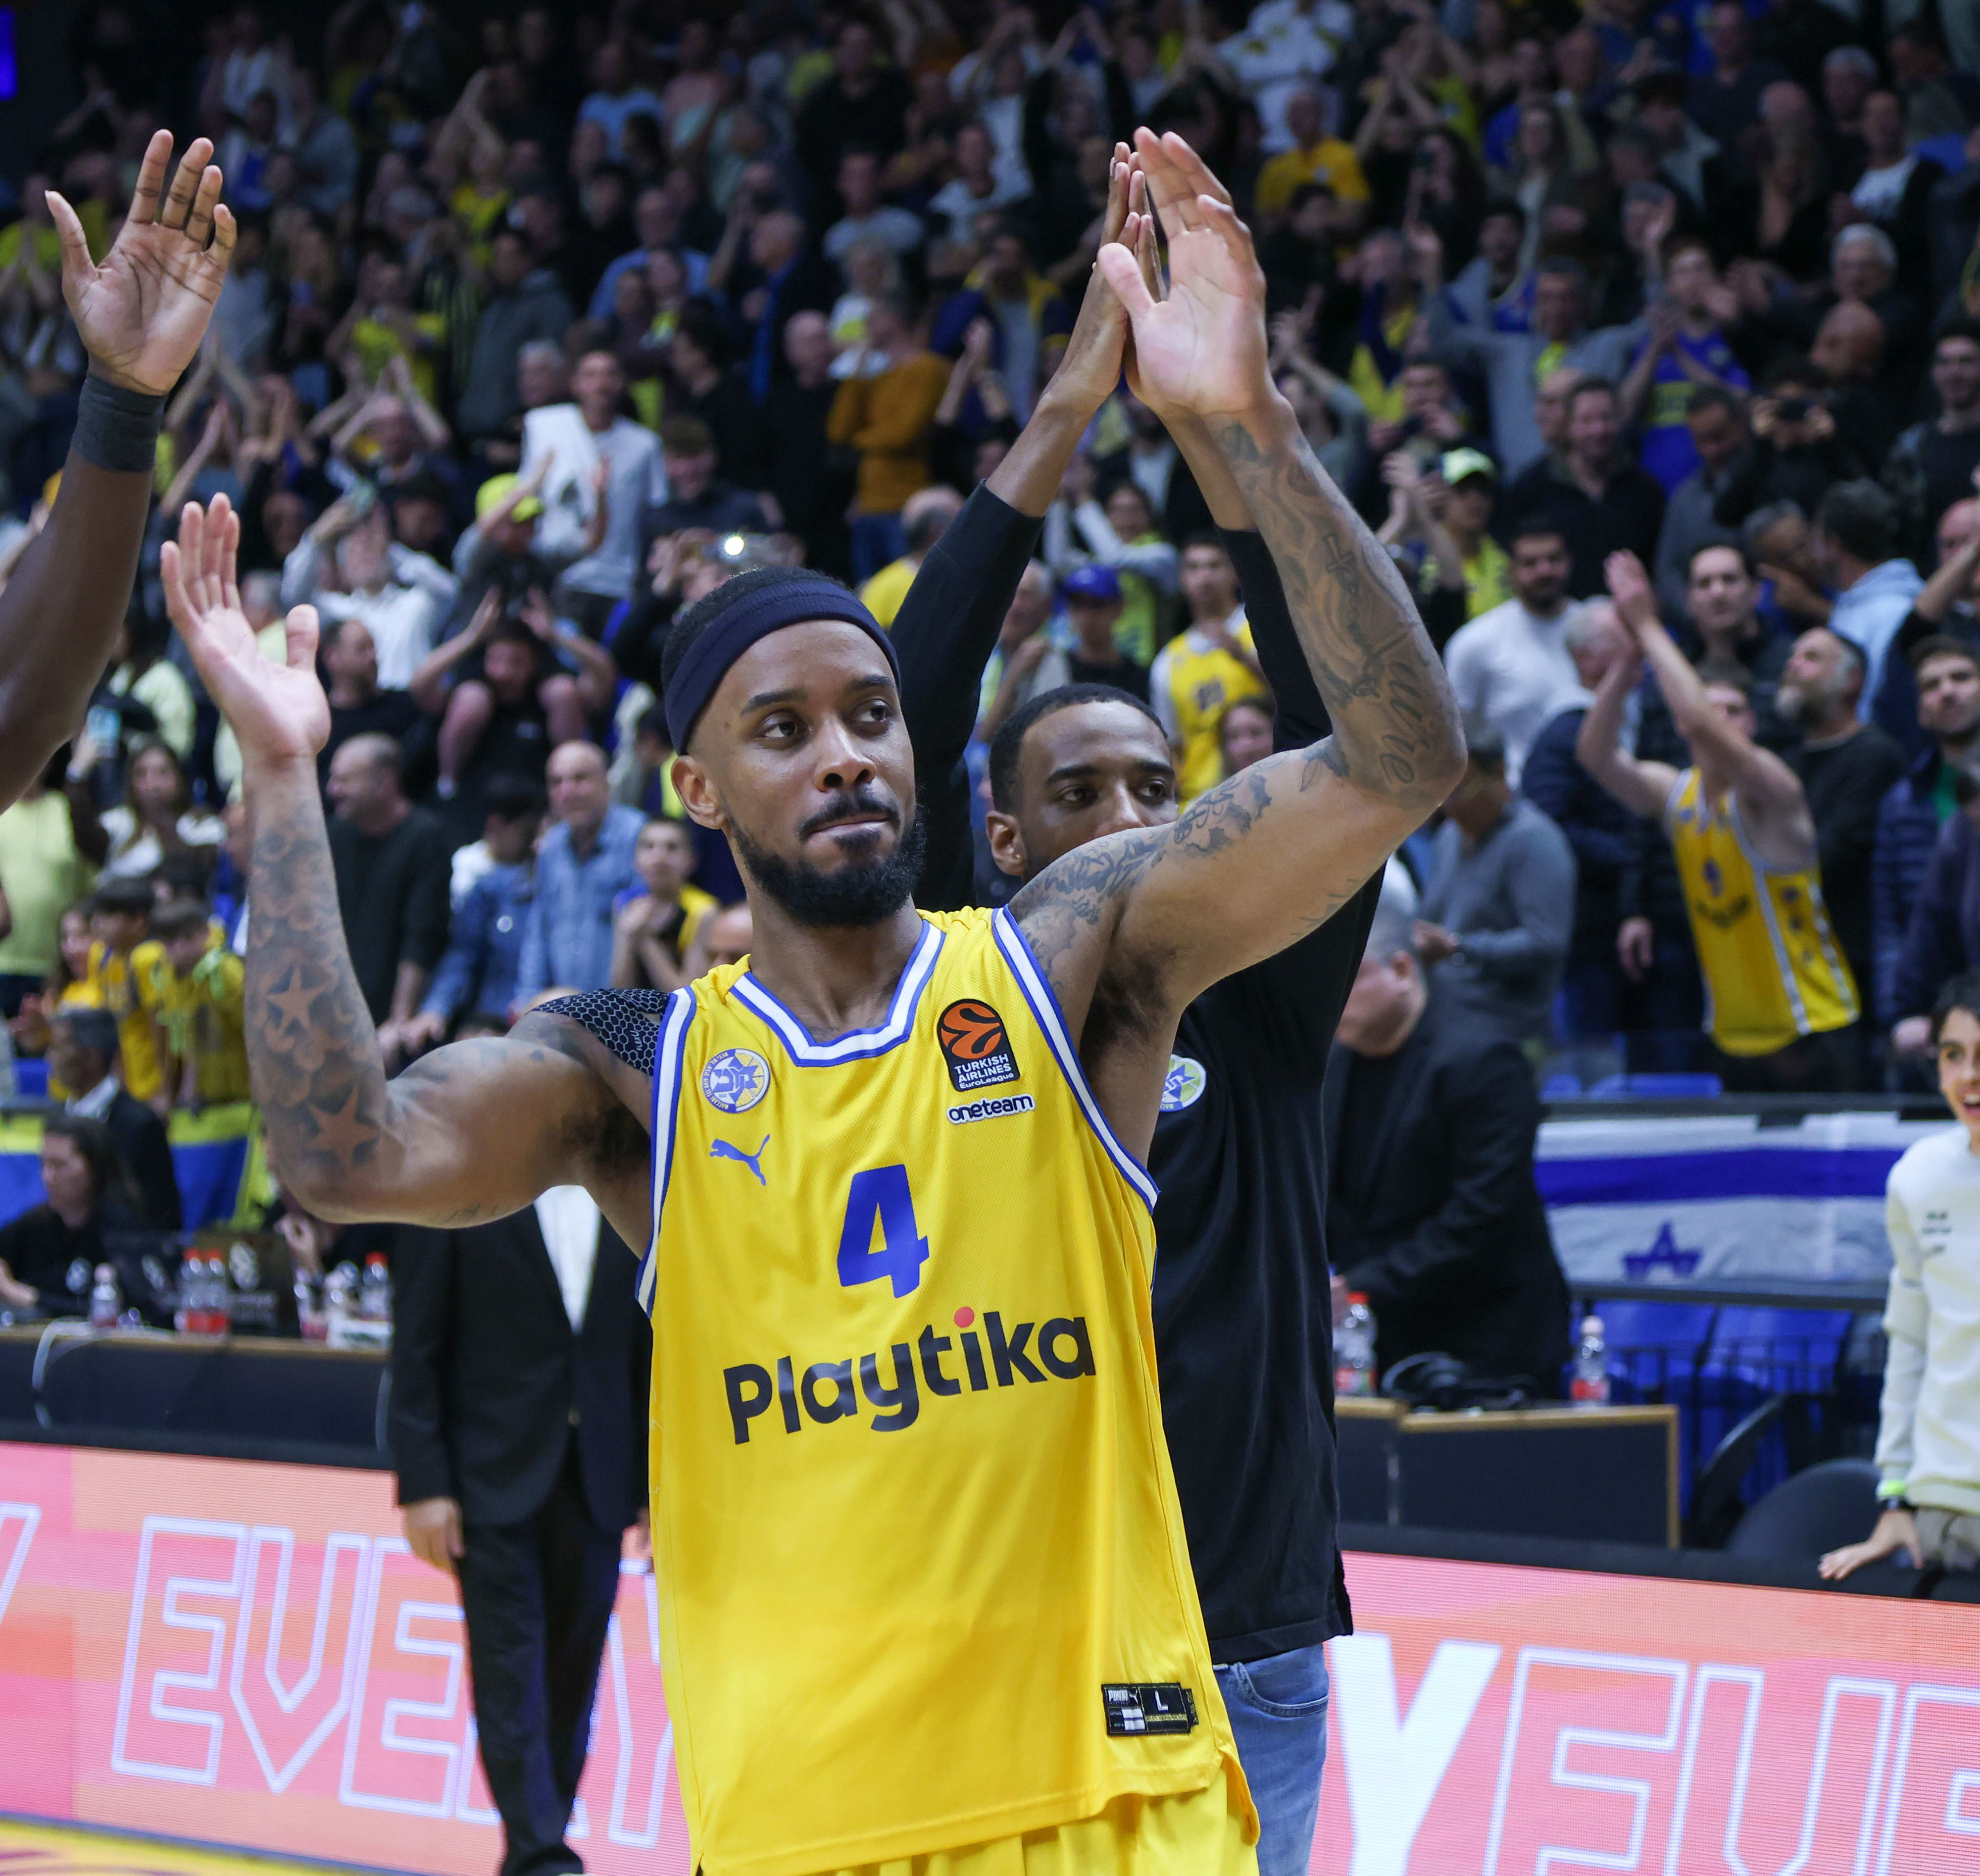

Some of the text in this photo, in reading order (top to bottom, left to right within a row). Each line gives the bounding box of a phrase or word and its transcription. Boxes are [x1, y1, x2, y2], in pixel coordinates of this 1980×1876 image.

[954, 1054, 1009, 1074] TURKISH
[958, 1063, 1012, 1083] AIRLINES
[959, 1073, 1014, 1089] EuroLeague
[949, 1096, 1033, 1121] oneteam
[838, 1164, 929, 1298] 4
[723, 1306, 1096, 1445] Playtika
[1154, 1689, 1169, 1711] L
